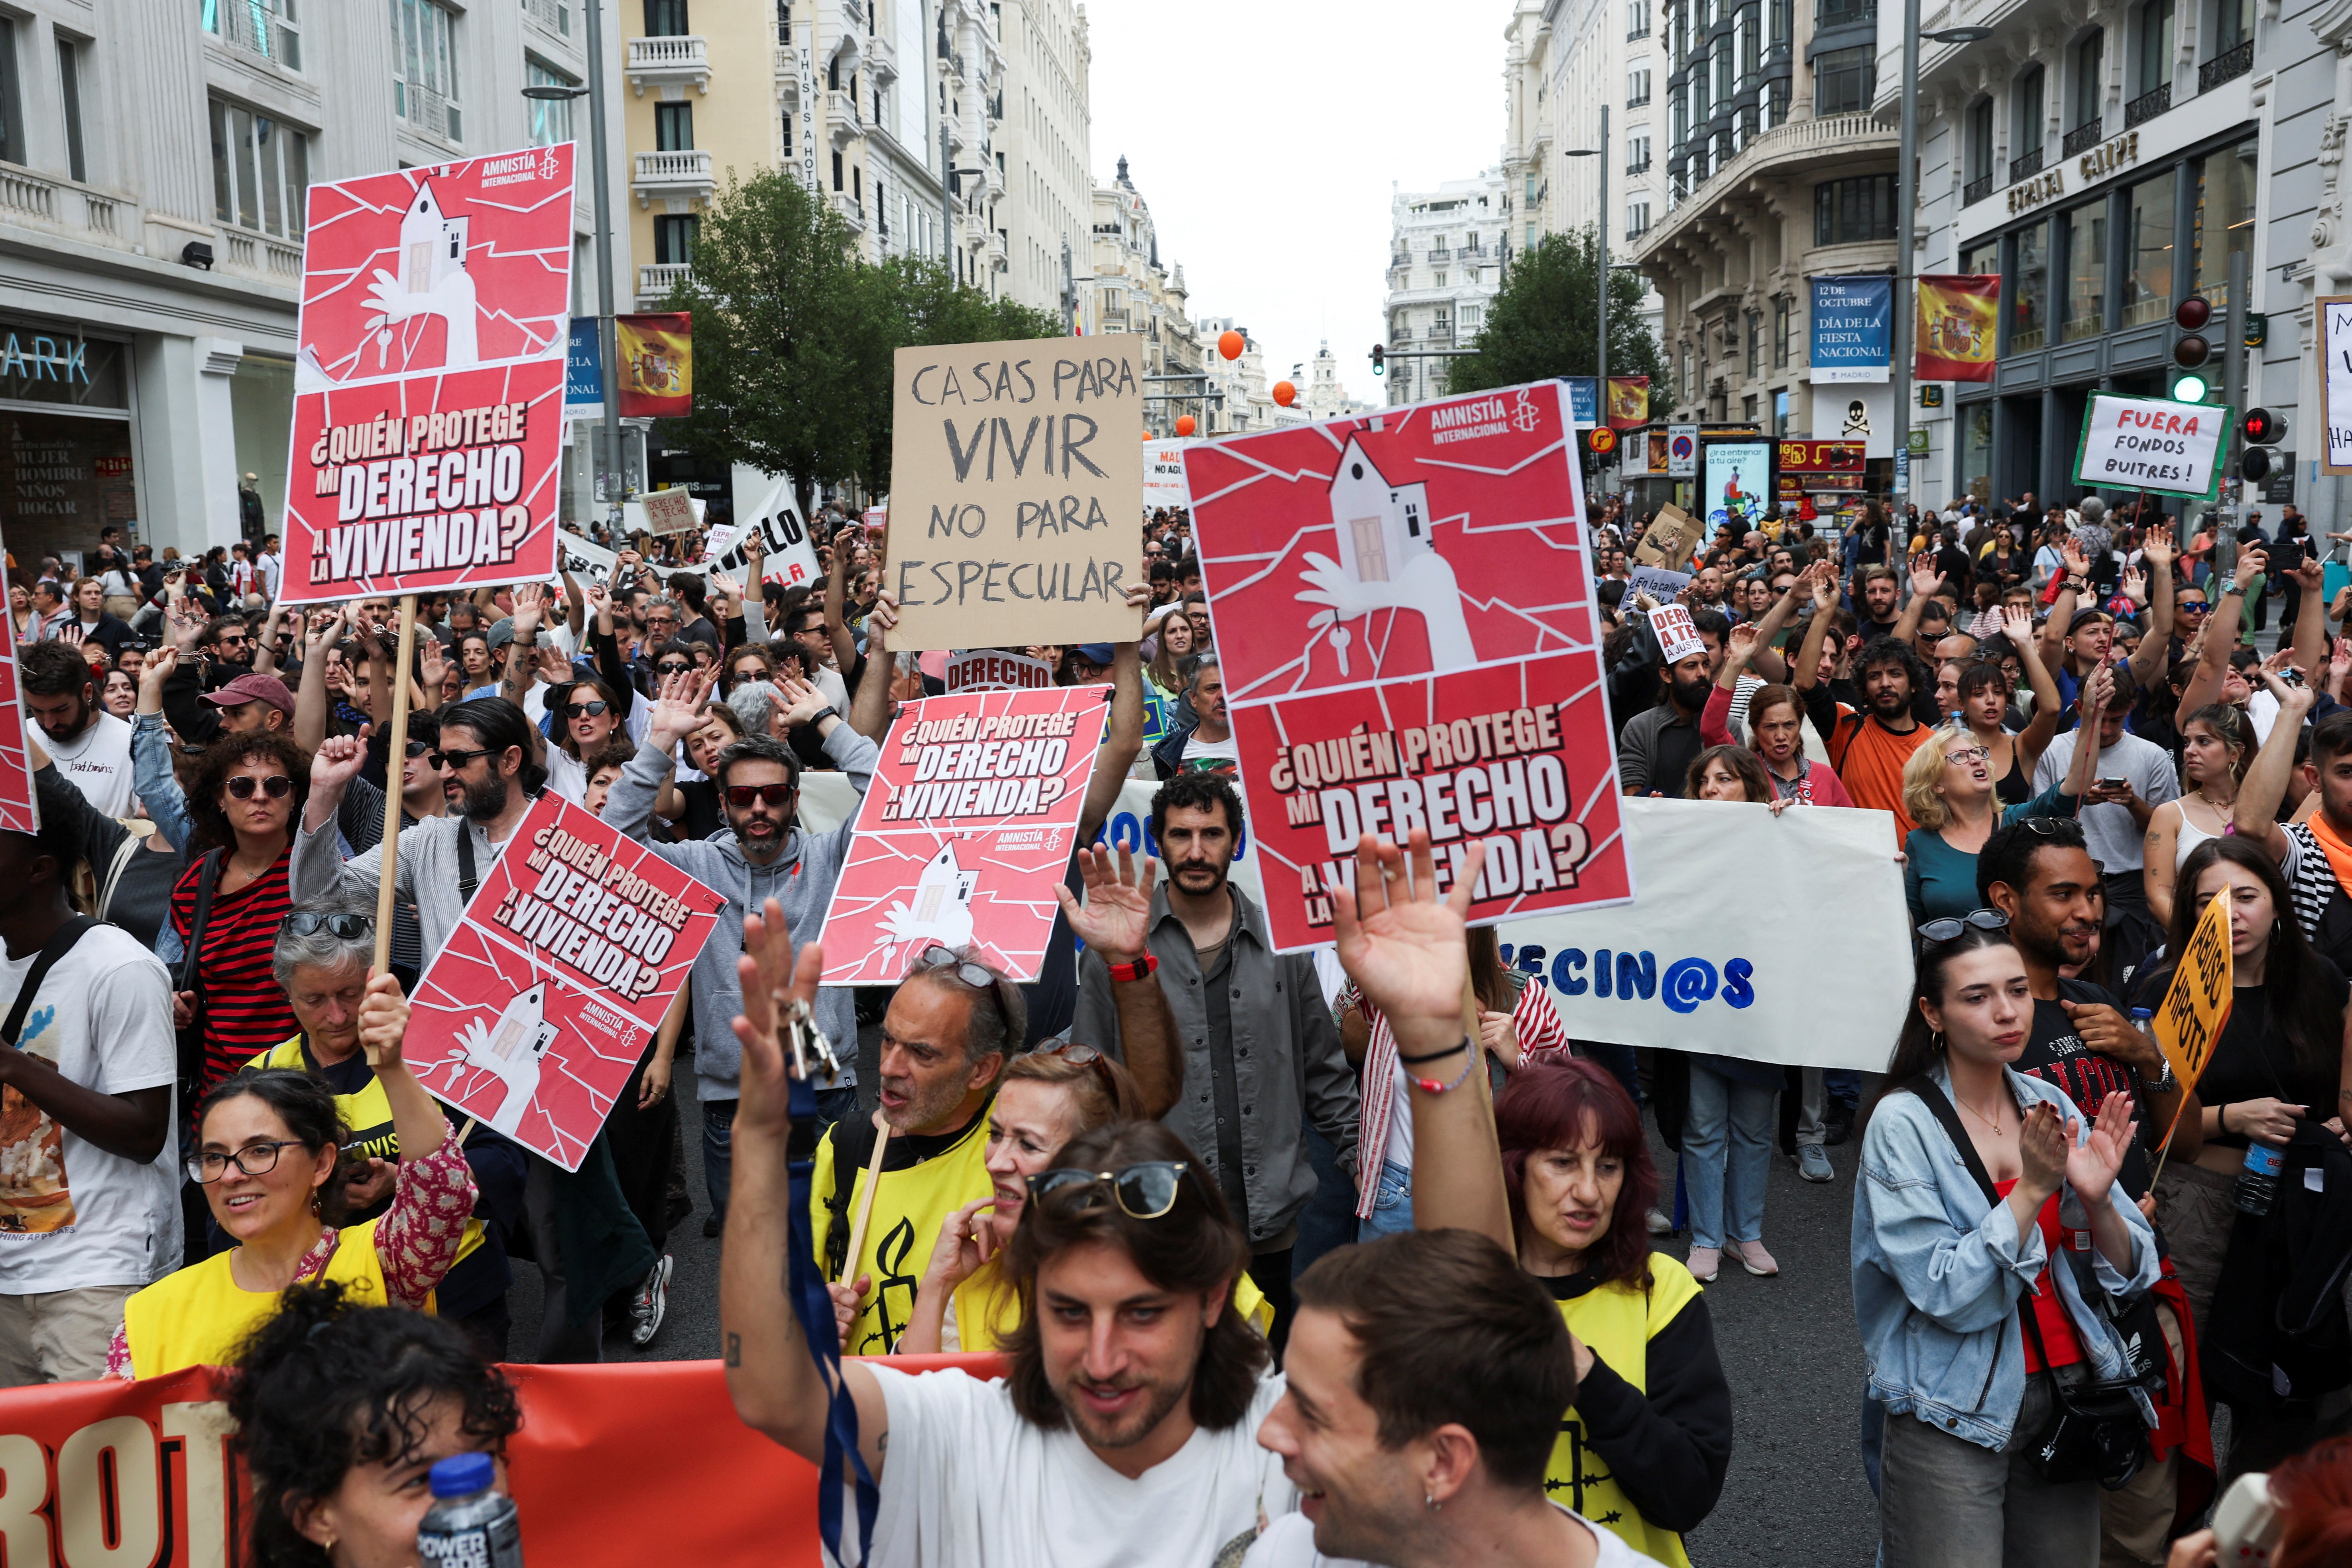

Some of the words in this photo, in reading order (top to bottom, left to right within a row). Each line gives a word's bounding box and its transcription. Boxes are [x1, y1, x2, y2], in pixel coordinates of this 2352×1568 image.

[800, 48, 810, 94] THIS
[804, 100, 811, 122] IS
[482, 152, 536, 177] AMNISTÍA
[804, 147, 814, 193] HOTE
[2006, 168, 2064, 213] ESPASA
[2080, 131, 2139, 179] CALPE
[482, 171, 536, 188] INTERNACIONAL
[1819, 286, 1829, 295] 12
[1831, 286, 1846, 295] DE
[1819, 297, 1872, 307] OCTUBRE
[1819, 317, 1843, 329] DÍA
[1845, 319, 1862, 329] DE
[1864, 318, 1881, 328] LA
[1819, 333, 1861, 343] FIESTA
[576, 356, 592, 367] LA
[1819, 346, 1884, 358] NACIONAL
[912, 359, 1036, 405] CASAS
[1053, 357, 1137, 403] PARA
[1431, 395, 1506, 430] AMNISTÍA
[2117, 409, 2199, 436] FUERA
[311, 409, 405, 466] ¿QUIÉN
[411, 401, 528, 454] PROTEGE
[1433, 419, 1510, 445] INTERNACIONAL
[13, 450, 70, 464] MUJER
[943, 412, 1110, 483] VIVIR
[2114, 435, 2185, 455] FONDOS
[14, 467, 87, 481] HOMBRE
[1155, 465, 1166, 474] NO
[15, 482, 66, 498] NIÑOS
[316, 468, 340, 497] MI
[338, 445, 524, 523] DERECHO
[17, 501, 77, 515] HOGAR
[647, 496, 686, 511] DERECHO
[652, 511, 659, 519] A
[661, 506, 688, 517] TECHO
[928, 503, 986, 539] NO
[1017, 495, 1108, 541] PARA
[312, 529, 327, 557] A
[330, 505, 531, 582] VIVIENDA?
[713, 530, 733, 539] EXPR
[310, 558, 331, 585] LA
[898, 556, 1130, 606] ESPECULAR
[1649, 579, 1658, 590] la
[1652, 608, 1694, 631] DERE
[1660, 630, 1674, 649] A
[1668, 649, 1675, 658] A
[948, 657, 1048, 692] DERECHO
[901, 711, 981, 747] ¿QUIÉN
[979, 712, 1079, 742] PROTEGE
[899, 746, 921, 766] MI
[912, 738, 1070, 783] DERECHO
[1270, 722, 1401, 793] ¿QUIÉN
[1404, 703, 1564, 775] PROTEGE
[70, 760, 87, 772] bad
[887, 785, 902, 804] A
[897, 777, 1067, 820] VIVIENDA?
[1284, 792, 1323, 828] MI
[1319, 754, 1571, 858] DERECHO
[881, 804, 899, 821] LA
[995, 842, 1041, 852] INTERNACIONAL
[997, 829, 1043, 843] AMNISTÍA
[526, 848, 549, 874] MI
[533, 823, 612, 882] ¿QUIÉN
[604, 863, 692, 933] PROTEGE
[1300, 864, 1323, 897] A
[502, 886, 518, 908] A
[492, 905, 516, 929] LA
[533, 861, 675, 967] DERECHO
[1304, 897, 1335, 929] LA
[508, 893, 661, 1004] VIVIENDA?
[1499, 944, 1755, 1014] ECIN@S
[579, 1012, 619, 1039] INTERNACIONAL
[583, 1001, 624, 1030] AMNISTÍA
[27, 1226, 76, 1241] APPEARS
